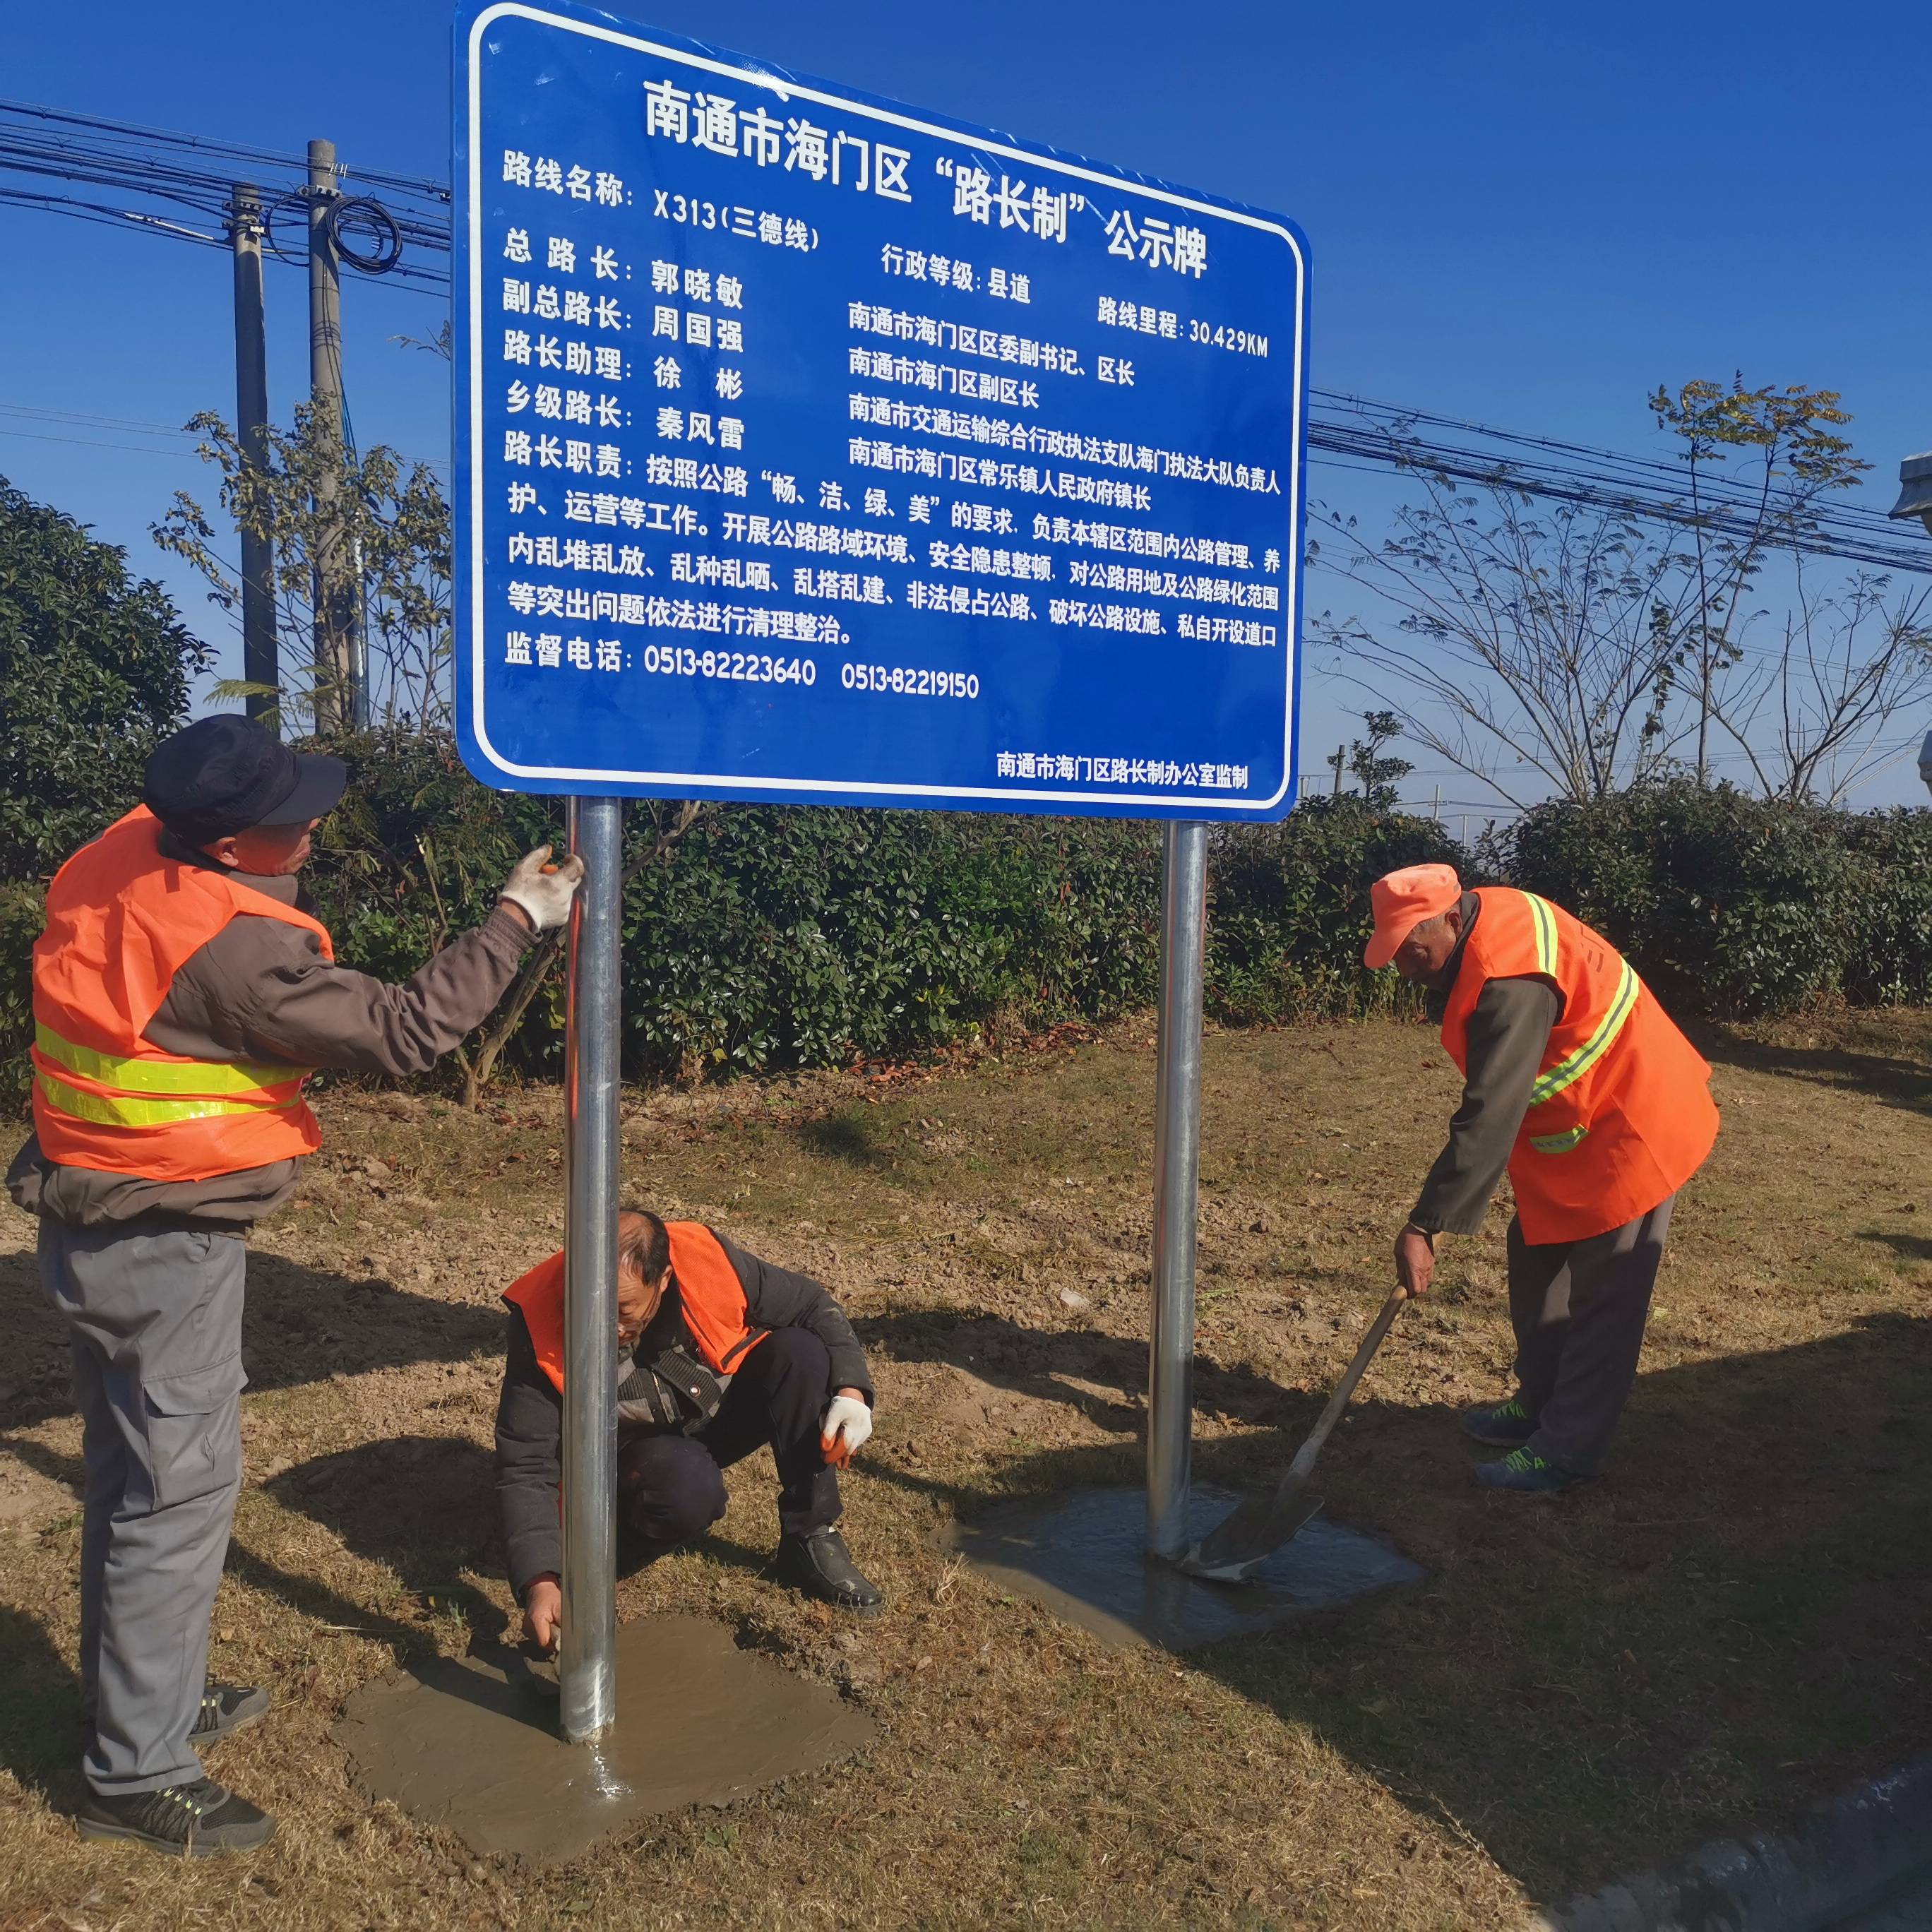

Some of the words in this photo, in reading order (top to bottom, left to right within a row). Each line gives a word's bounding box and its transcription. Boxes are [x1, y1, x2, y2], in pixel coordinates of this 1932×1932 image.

[643, 80, 1208, 279] 南通市海门区“路长制”公示牌
[653, 189, 818, 253] X313(三德线)
[651, 259, 744, 310] 郭晓敏
[652, 305, 744, 353] 周国强
[848, 301, 1135, 386] 南通市海门区区委副书记、区长
[848, 346, 1039, 409] 南通市海门区副区长
[656, 406, 744, 451] 秦风雷
[848, 392, 1281, 495] 南通市交通运输综合行政执法支队海门执法大队负责人
[848, 436, 1152, 511] 南通市海门区常乐镇人民政府镇长
[507, 580, 850, 645] 等突出问题依法进行清理整治。
[644, 645, 816, 686] 0513-82223640
[841, 662, 979, 699] 0513-82219150
[996, 751, 1248, 789] 南通市海门区路长制办公室监制
